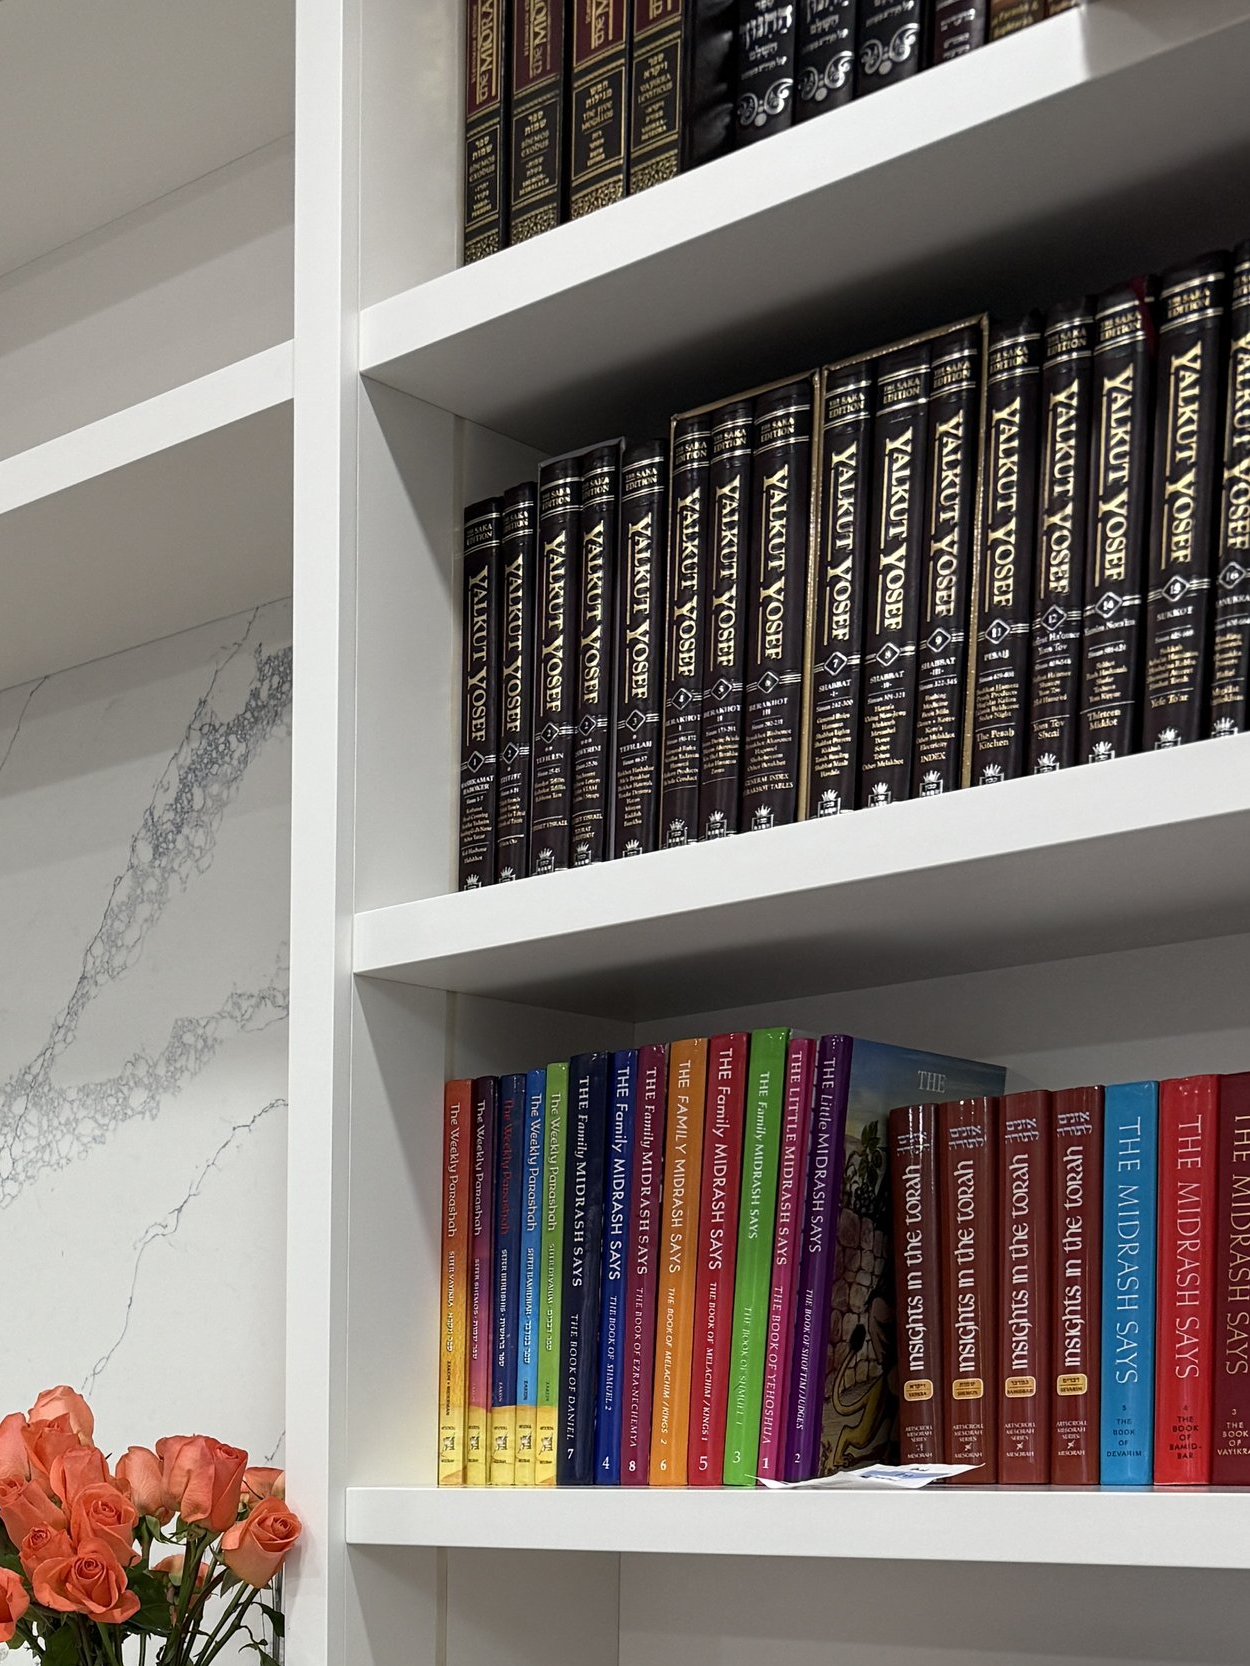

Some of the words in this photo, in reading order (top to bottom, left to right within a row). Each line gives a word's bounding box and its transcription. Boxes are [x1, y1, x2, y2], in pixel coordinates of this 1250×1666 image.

[1104, 363, 1134, 485] YALKUT
[1172, 341, 1202, 465] YALKUT
[936, 409, 964, 522] YALKUT
[993, 397, 1021, 512] YALKUT
[1050, 379, 1078, 497] YALKUT
[832, 441, 857, 550] YALKUT
[886, 426, 913, 538] YALKUT
[678, 487, 701, 591] YALKUT
[716, 475, 740, 581] YALKUT
[763, 464, 788, 571] YALKUT
[1099, 488, 1128, 582] YOSEF
[1166, 468, 1196, 564] YOSEF
[584, 520, 603, 621] YALKUT
[629, 512, 651, 615] YALKUT
[931, 527, 958, 618] YOSEF
[988, 516, 1016, 607] YOSEF
[1044, 502, 1073, 594] YOSEF
[505, 554, 523, 656] YALKUT
[545, 530, 565, 630] YALKUT
[827, 555, 853, 641] YOSEF
[880, 543, 906, 632] YOSEF
[470, 565, 488, 662] YALKUT
[674, 595, 697, 676] YOSEF
[713, 584, 737, 667] YOSEF
[760, 576, 785, 660] YOSEF
[542, 632, 562, 712] YOSEF
[582, 625, 602, 704] YOSEF
[627, 620, 649, 699] YOSEF
[468, 666, 487, 742] YOSEF
[503, 655, 522, 732] YOSEF
[579, 1076, 589, 1109] THE
[616, 1067, 630, 1097] THE
[646, 1067, 657, 1099] THE
[678, 1061, 691, 1088] THE
[718, 1048, 732, 1080] THE
[758, 1072, 770, 1096] THE
[790, 1051, 802, 1083] THE
[822, 1058, 836, 1089] THE
[918, 1071, 946, 1093] THE
[451, 1103, 460, 1125] The
[477, 1100, 486, 1123] The
[531, 1093, 543, 1117] The
[551, 1093, 561, 1115] The
[612, 1103, 628, 1152] Family
[640, 1105, 655, 1148] Family
[676, 1096, 689, 1154] FAMILY
[712, 1086, 730, 1137] Family
[755, 1101, 768, 1142] Family
[785, 1087, 799, 1141] LITTLE
[818, 1095, 832, 1129] Little
[448, 1127, 459, 1172] Weekly
[476, 1125, 485, 1170] Weekly
[527, 1119, 541, 1164] Weekly
[548, 1117, 560, 1163] Weekly
[575, 1114, 588, 1158] Family
[1118, 1117, 1140, 1172] THE
[1177, 1115, 1201, 1169] THE
[573, 1161, 586, 1242] MIDRASH
[611, 1159, 625, 1234] MIDRASH
[639, 1152, 653, 1231] MIDRASH
[671, 1159, 685, 1227] MIDRASH
[711, 1143, 728, 1223] MIDRASH
[750, 1145, 764, 1204] MIDRASH
[780, 1147, 795, 1222] MIDRASH
[812, 1134, 830, 1210] MIDRASH
[669, 1234, 681, 1273] SAYS
[708, 1229, 723, 1269] SAYS
[748, 1209, 759, 1239] SAYS
[777, 1227, 789, 1265] SAYS
[809, 1216, 824, 1253] SAYS
[904, 1230, 922, 1266] the
[954, 1227, 974, 1265] the
[1009, 1222, 1028, 1260] the
[1062, 1216, 1083, 1253] the
[1117, 1185, 1140, 1310] MIDRASH
[1176, 1182, 1200, 1307] MIDRASH
[1228, 1174, 1250, 1302] MIDRASH
[572, 1247, 582, 1286] SAYS
[609, 1241, 622, 1280] SAYS
[637, 1236, 649, 1274] SAYS
[1116, 1321, 1138, 1384] SAYS
[1176, 1317, 1199, 1379] SAYS
[1226, 1312, 1249, 1375] SAYS
[567, 1449, 574, 1459] 7
[602, 1456, 610, 1470] 4
[629, 1461, 636, 1471] 8
[699, 1456, 708, 1470] 5
